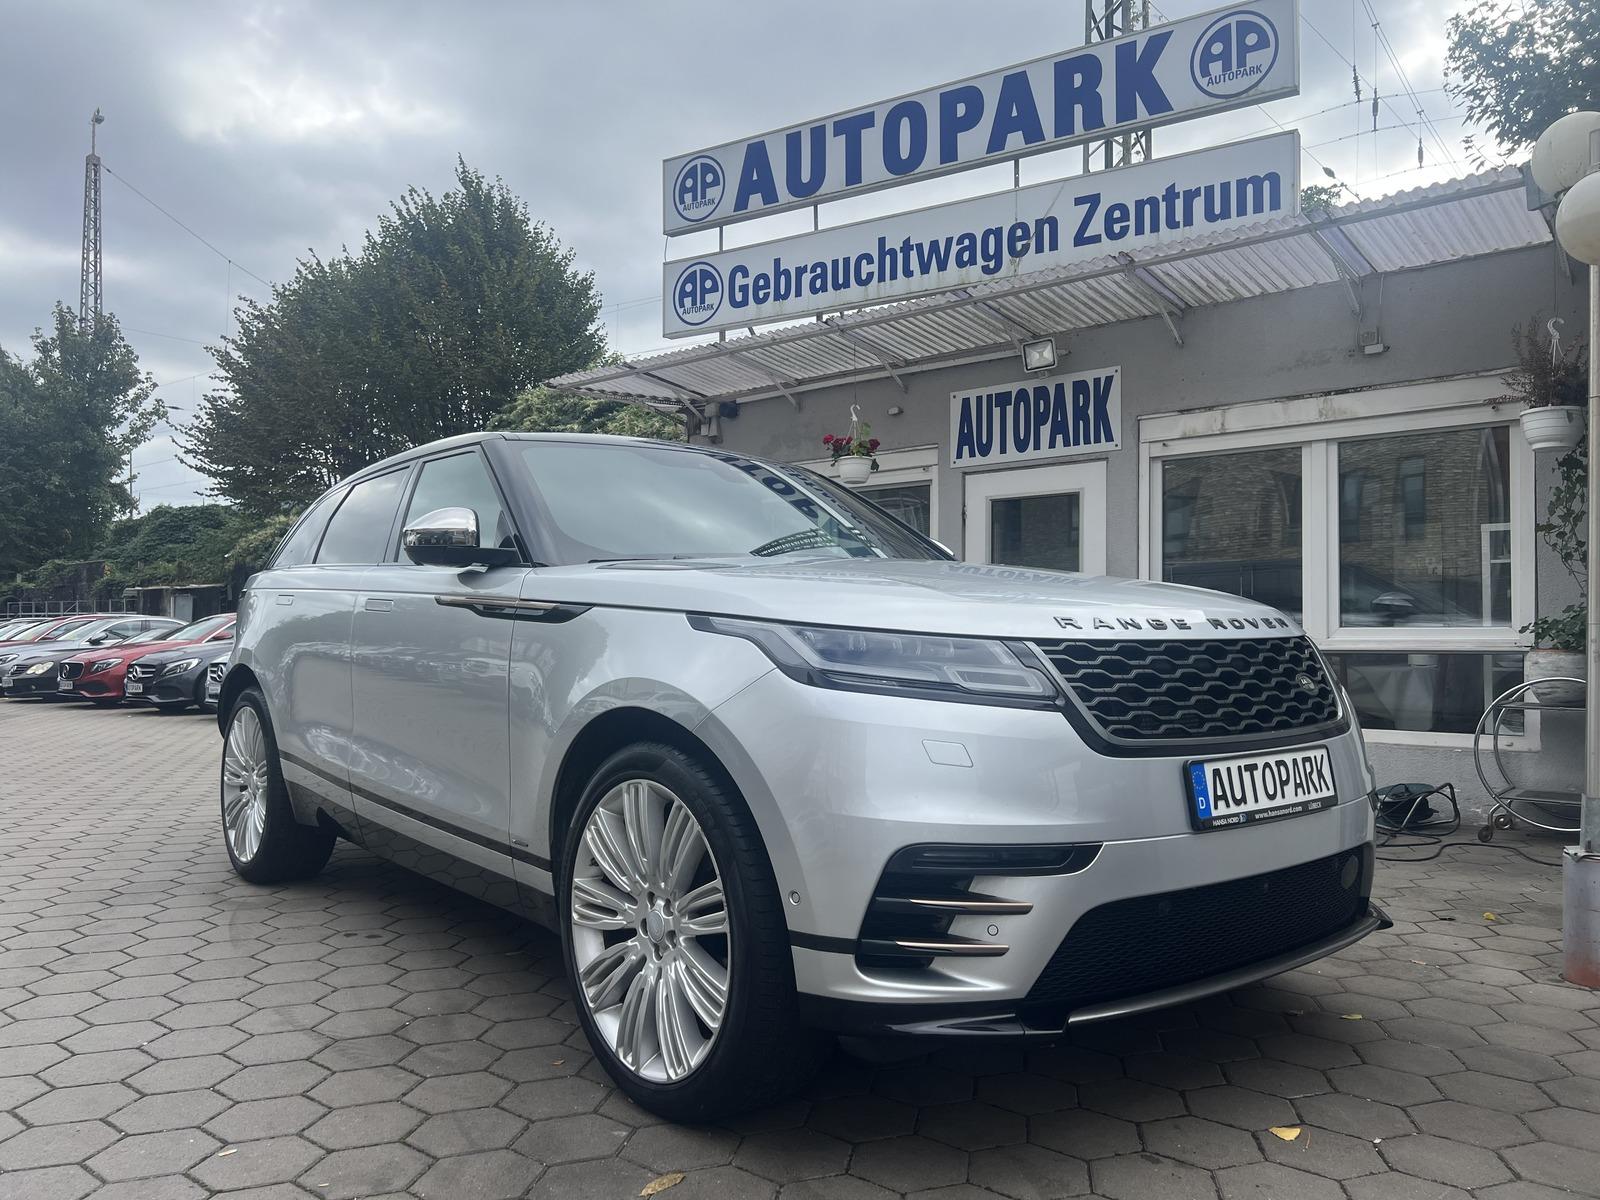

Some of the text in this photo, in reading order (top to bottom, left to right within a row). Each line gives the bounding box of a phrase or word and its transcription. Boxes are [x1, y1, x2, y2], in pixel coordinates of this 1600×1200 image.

[1207, 64, 1263, 87] AUTOPARK
[733, 30, 1175, 213] AUTOPARK
[682, 197, 716, 212] AUTOPARK
[727, 168, 1282, 310] Gebrauchtwagen Zentrum
[682, 302, 715, 316] AUTOPARK
[955, 374, 1115, 460] AUTOPARK
[1053, 615, 1290, 631] RANGE ROVER
[1198, 754, 1331, 811] D AUTOPARK
